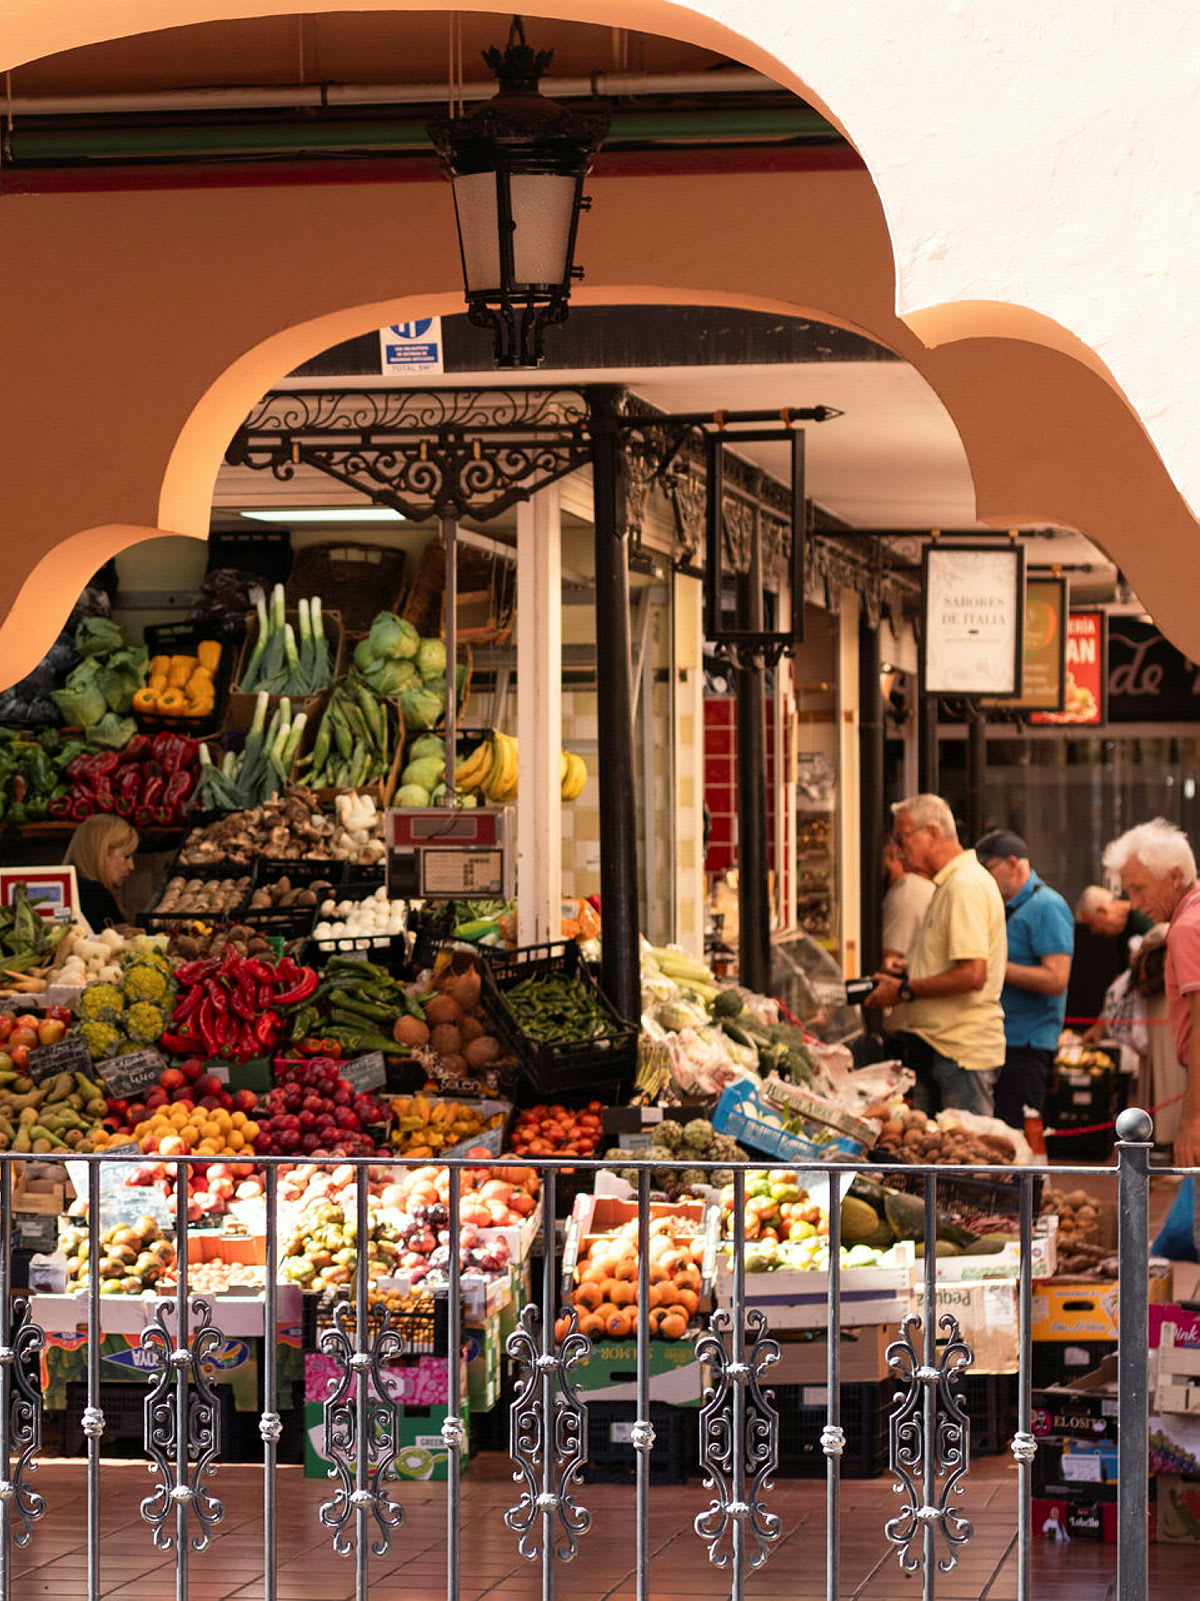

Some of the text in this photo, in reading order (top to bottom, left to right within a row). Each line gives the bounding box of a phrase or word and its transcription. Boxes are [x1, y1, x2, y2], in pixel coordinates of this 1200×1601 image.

[943, 595, 1005, 608] SABORES
[941, 613, 1007, 625] DE ITALIA
